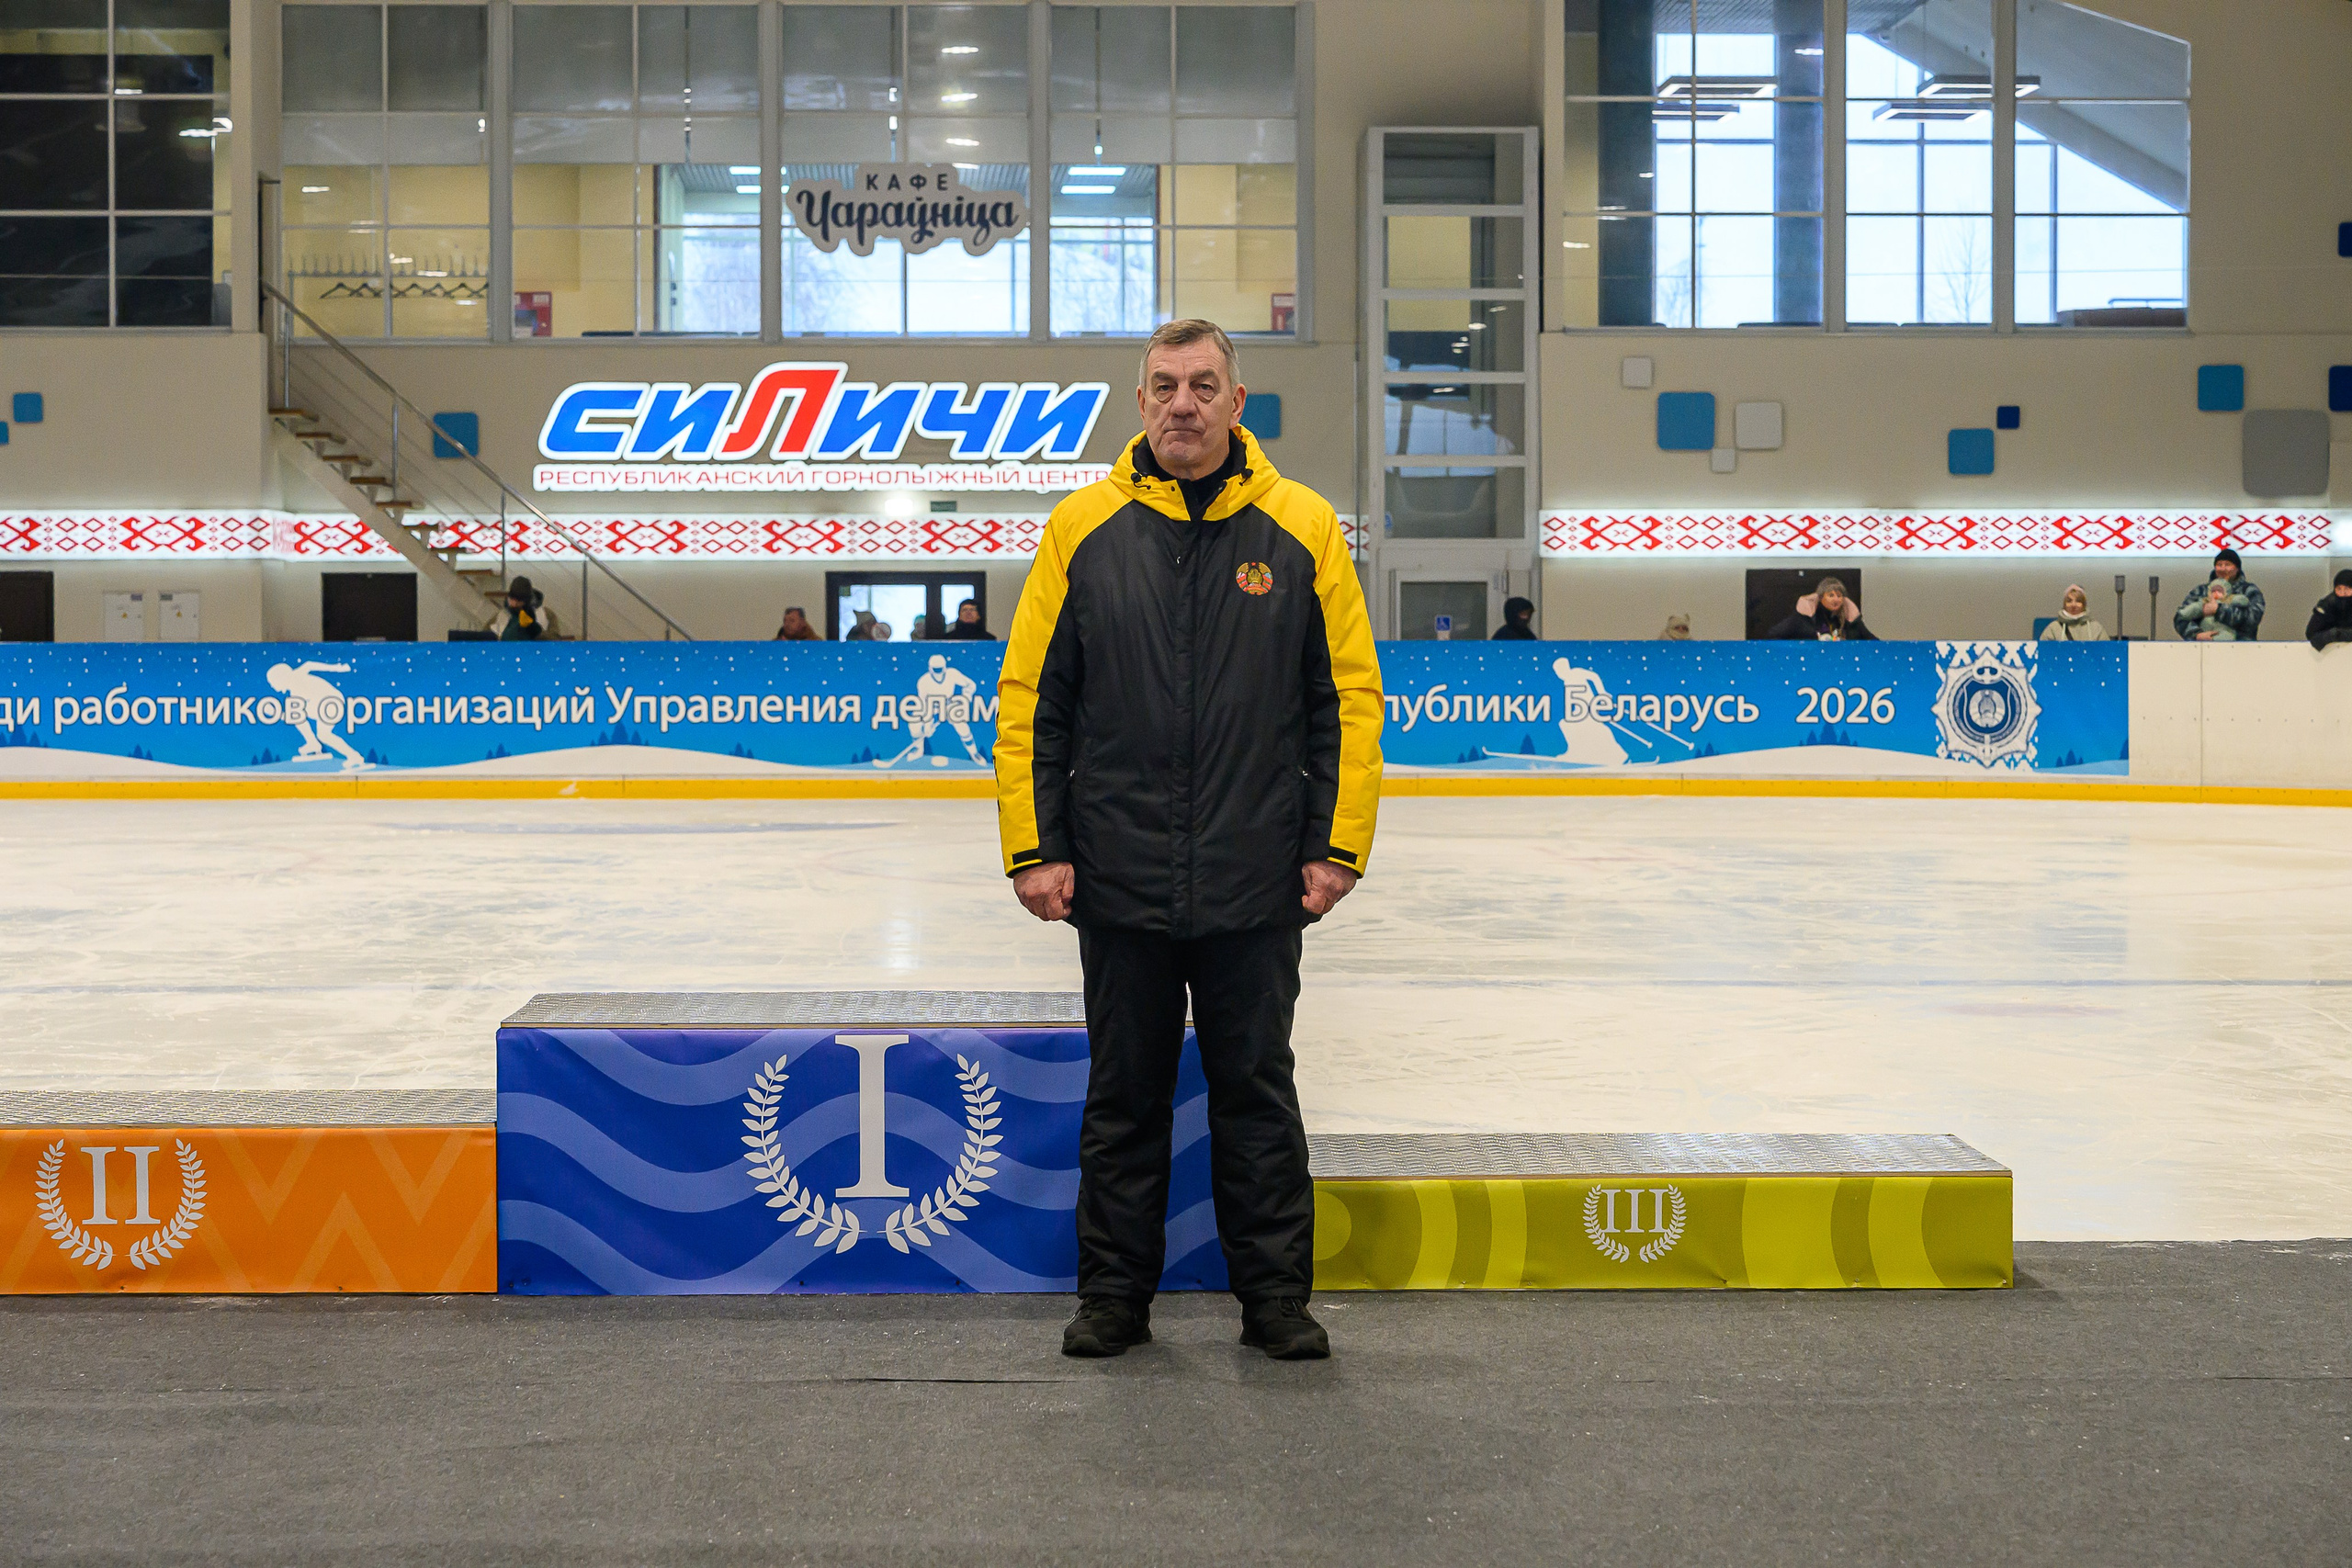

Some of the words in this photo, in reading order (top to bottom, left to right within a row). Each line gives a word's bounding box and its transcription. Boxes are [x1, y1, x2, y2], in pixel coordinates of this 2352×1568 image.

[865, 173, 949, 191] КАФЕ
[796, 189, 1019, 247] Чараўніца
[539, 468, 805, 485] РЕСПУБЛИКАНСКИЙ
[811, 467, 1020, 485] ГОРНОЛЫЖНЫЙ
[1028, 469, 1109, 488] ЦЕНТР
[54, 685, 308, 735] работников
[317, 685, 596, 735] организаций
[604, 685, 862, 733] Управления
[1563, 683, 1760, 733] Беларусь
[1794, 686, 1896, 725] 2026
[833, 1033, 910, 1199] I
[80, 1145, 161, 1225] II
[1600, 1188, 1670, 1234] III
